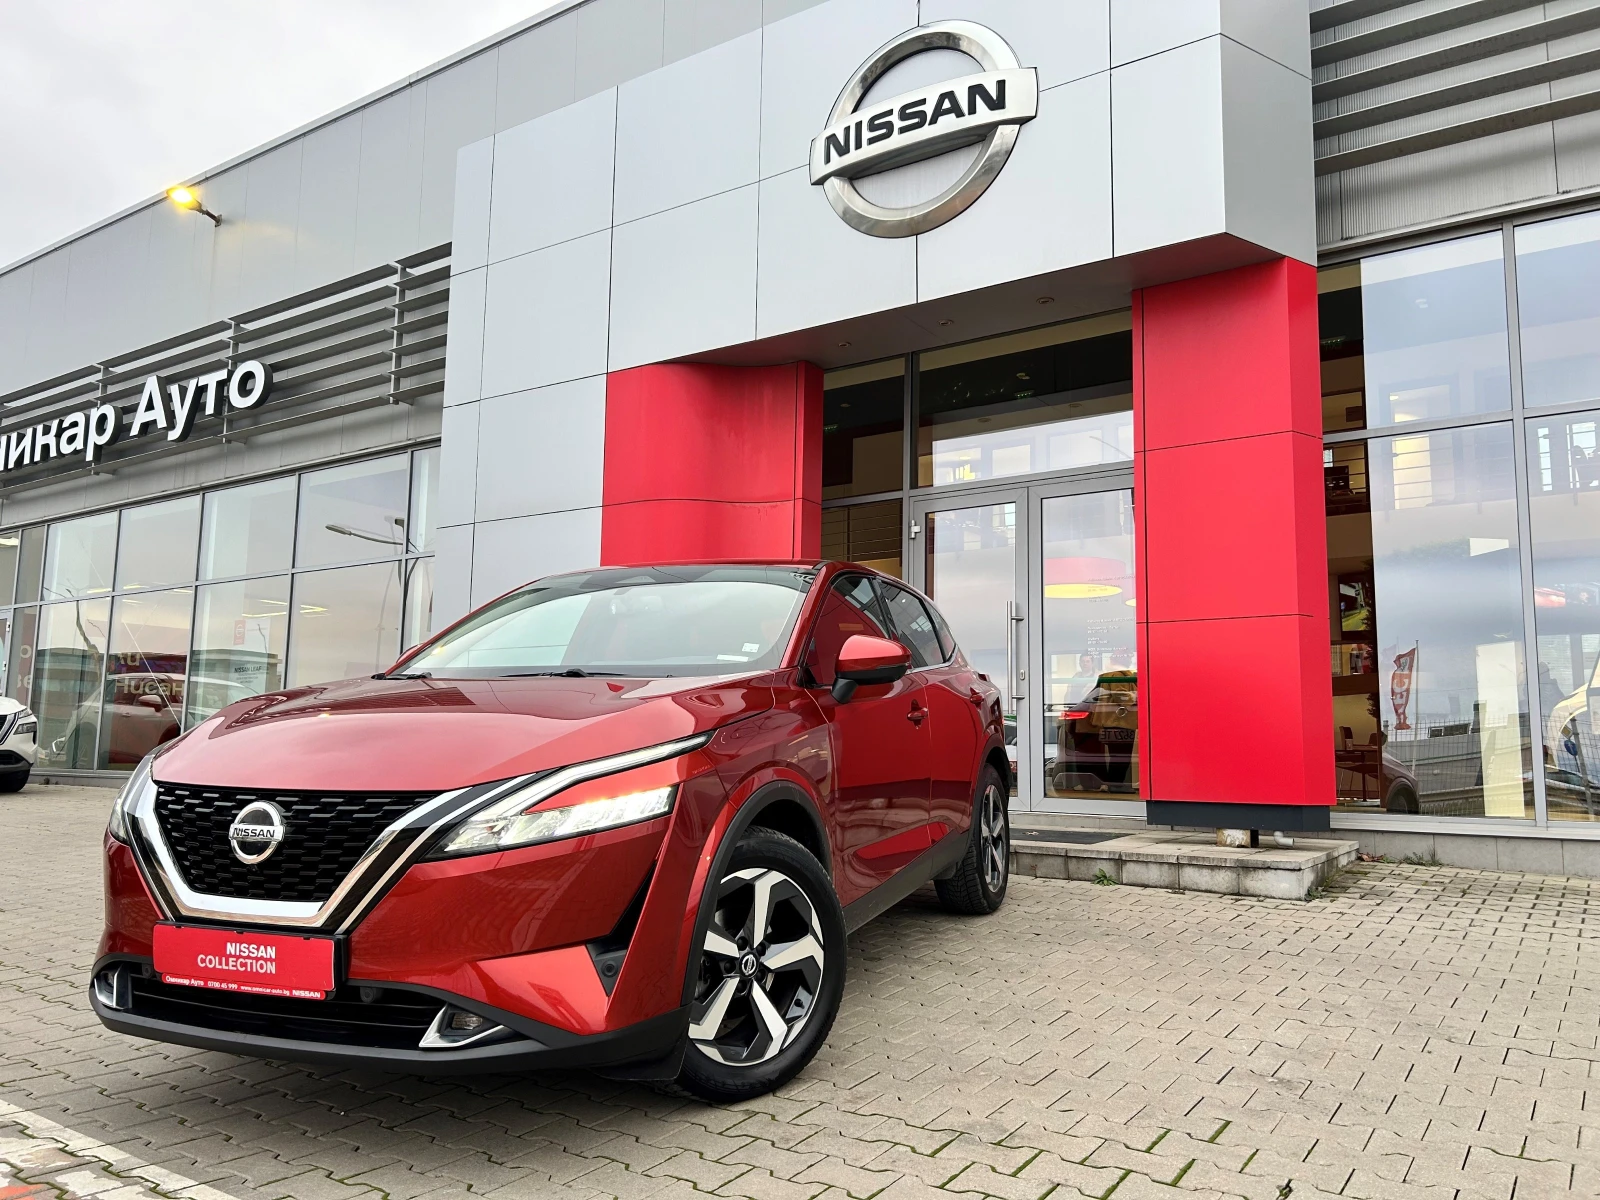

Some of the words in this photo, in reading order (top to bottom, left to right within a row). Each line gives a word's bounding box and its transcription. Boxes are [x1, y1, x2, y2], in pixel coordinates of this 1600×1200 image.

[824, 79, 1007, 165] NISSAN
[130, 360, 268, 441] Ауто
[233, 827, 276, 838] NISSAN
[226, 942, 276, 959] NISSAN
[197, 954, 276, 974] COLLECTION
[191, 978, 205, 987] Ауто
[292, 990, 321, 998] NISSAN
